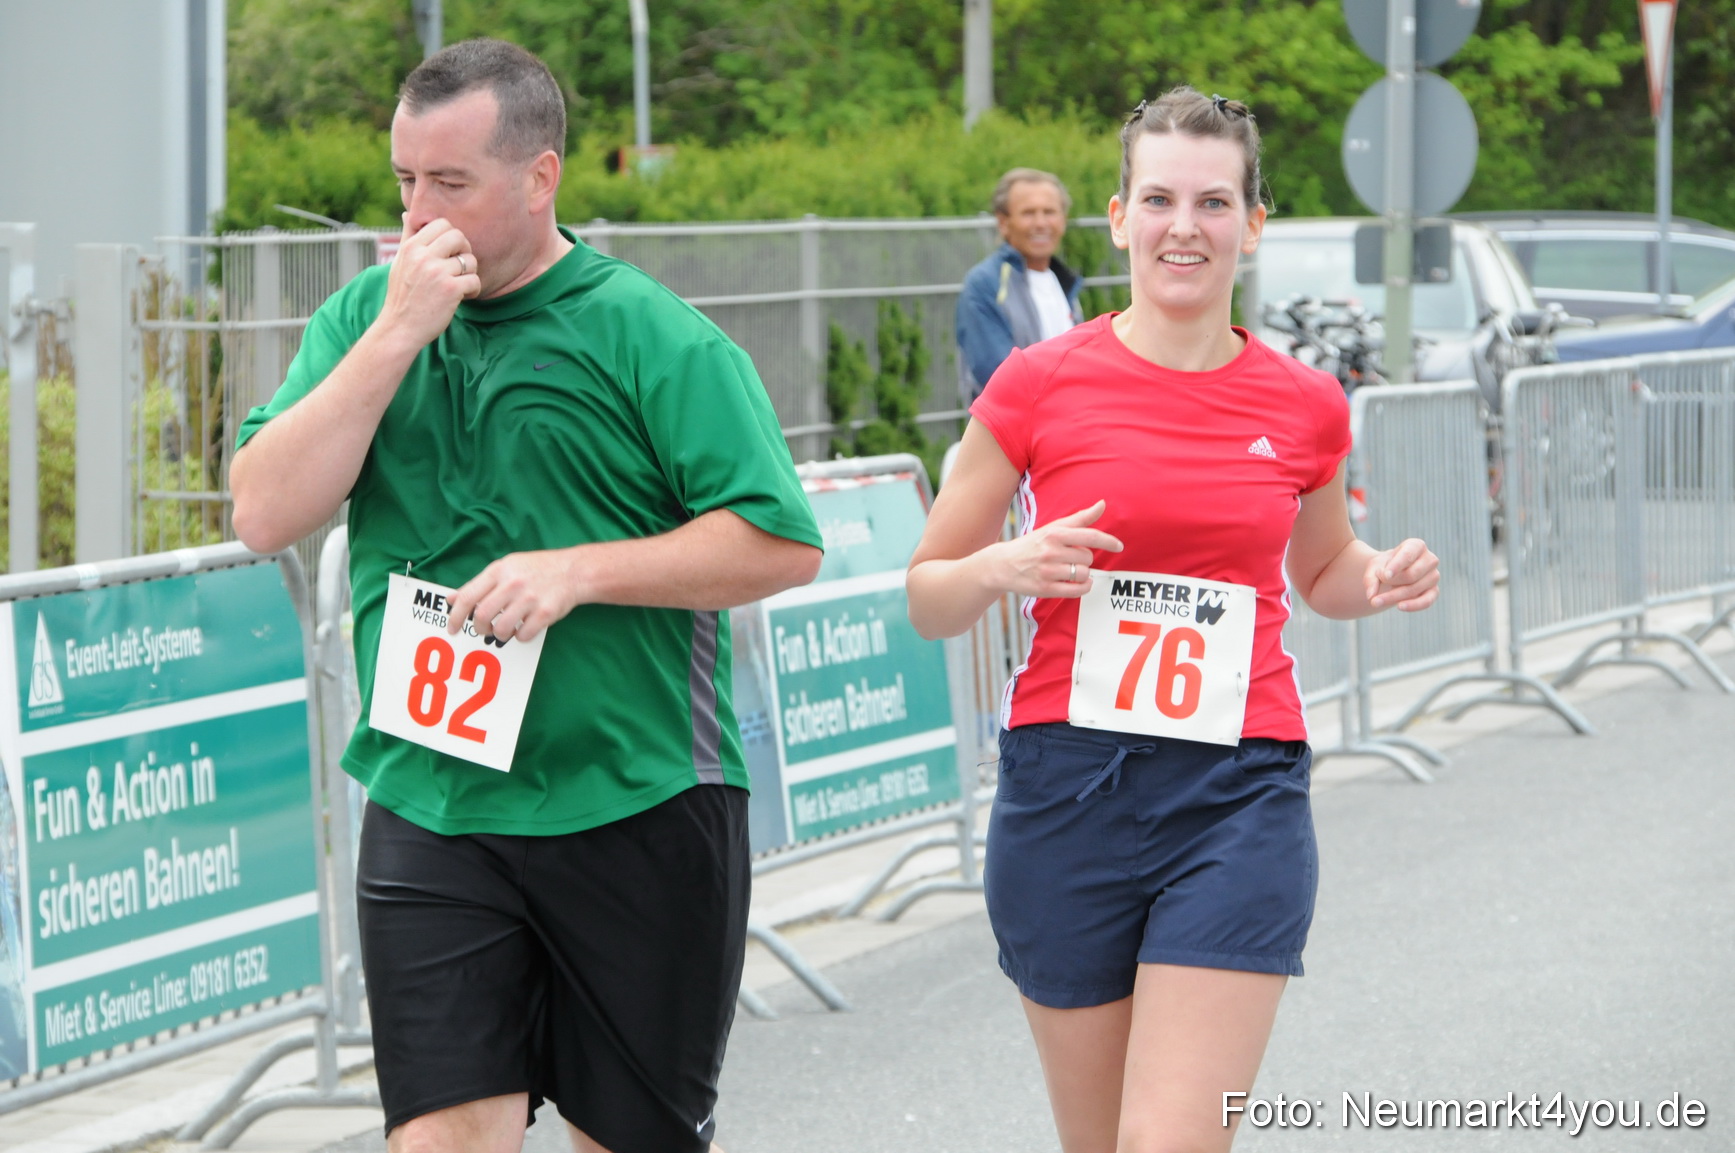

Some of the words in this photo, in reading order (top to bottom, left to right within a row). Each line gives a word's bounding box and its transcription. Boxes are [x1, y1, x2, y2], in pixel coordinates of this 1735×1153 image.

[1248, 445, 1277, 459] adidas
[1110, 579, 1192, 604] MEYER
[1110, 597, 1191, 618] WERBUNG
[65, 625, 203, 679] Event-Leit-Systeme
[774, 625, 809, 675] Fun
[868, 607, 888, 656] in
[1114, 620, 1206, 720] 76
[407, 636, 502, 744] 82
[33, 777, 81, 843] Fun
[86, 765, 108, 831] &
[112, 750, 188, 826] Action
[190, 741, 217, 806] in
[38, 862, 140, 939] sicheren
[144, 827, 241, 911] Bahnen!
[44, 999, 83, 1048] Miet
[84, 996, 99, 1036] &
[100, 981, 151, 1032] Service
[153, 972, 189, 1016] Line:
[190, 955, 232, 1003] 09181
[234, 944, 269, 990] 6352
